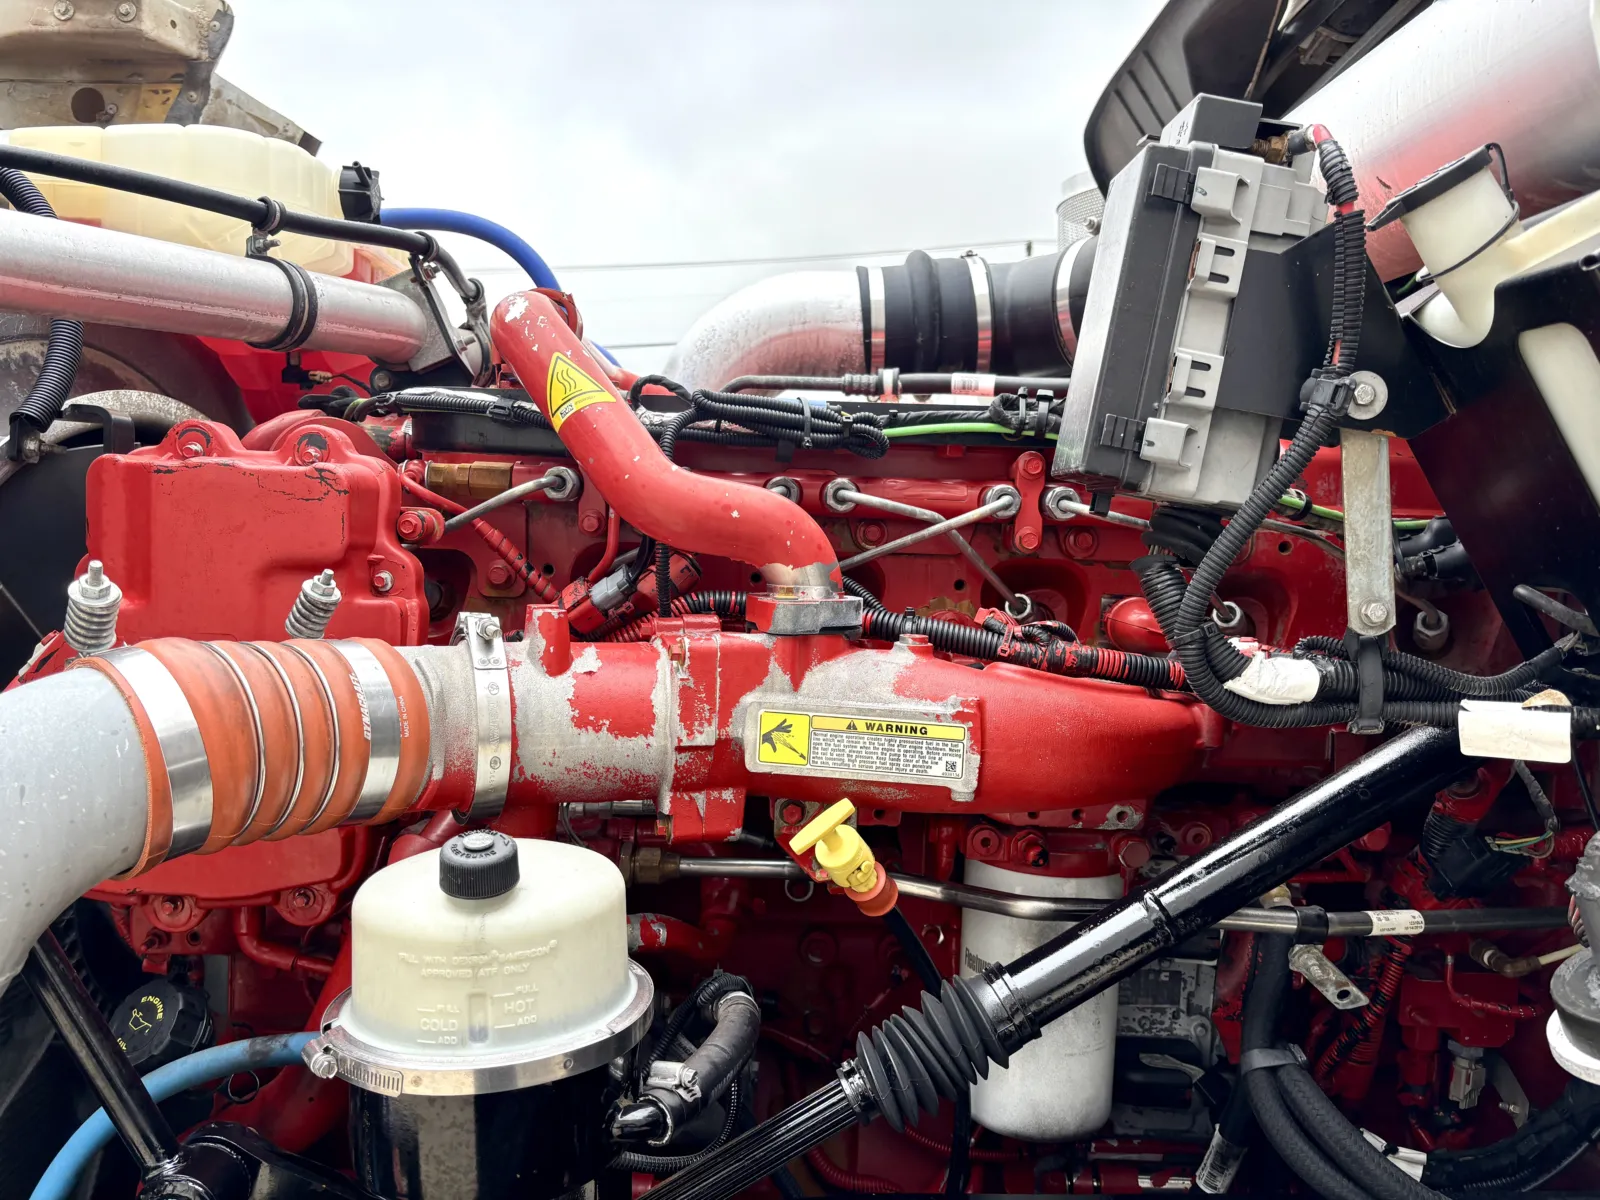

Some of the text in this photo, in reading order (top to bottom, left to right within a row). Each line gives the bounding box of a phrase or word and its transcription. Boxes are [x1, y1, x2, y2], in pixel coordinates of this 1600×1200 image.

[349, 672, 371, 740] DYNACRAFT
[864, 722, 928, 735] WARNING
[451, 844, 497, 858] FLEETGUARD
[422, 955, 447, 966] WITH
[420, 962, 530, 978] APPROVED ATF ONLY
[141, 996, 164, 1020] ENGINE
[504, 998, 534, 1014] HOT
[420, 1017, 458, 1032] COLD
[516, 1014, 537, 1026] ADD
[438, 1036, 458, 1044] ADD
